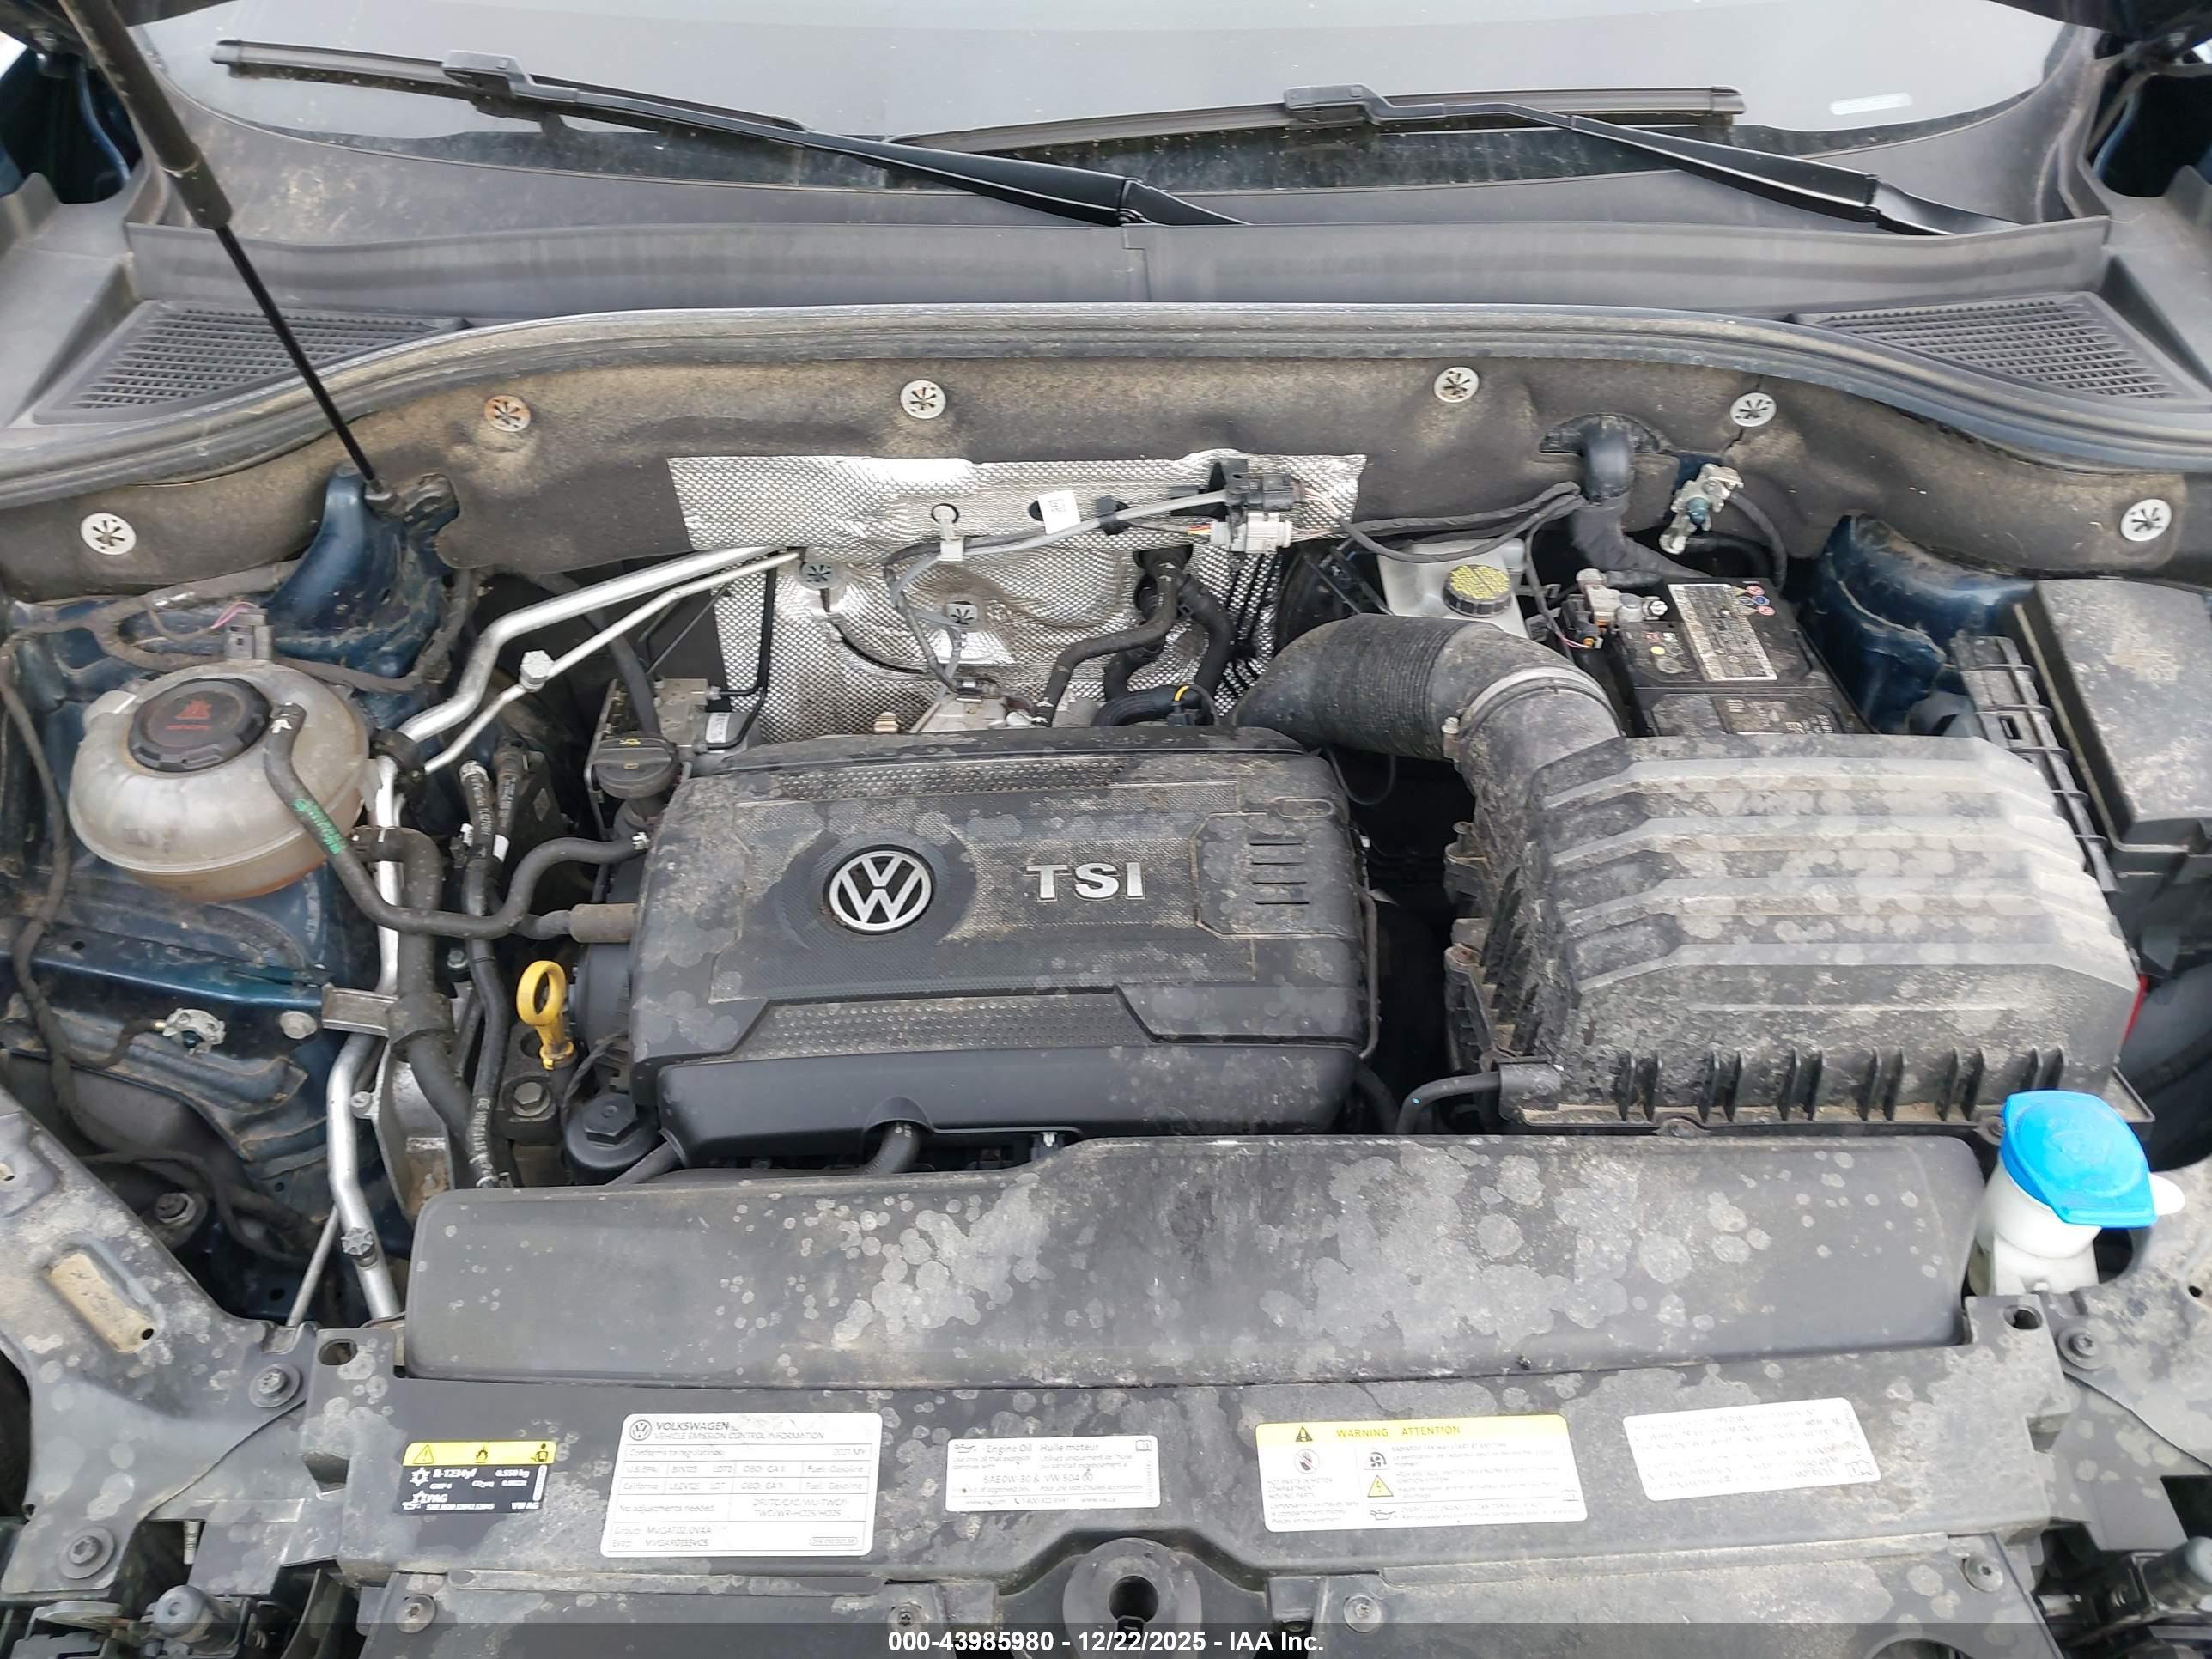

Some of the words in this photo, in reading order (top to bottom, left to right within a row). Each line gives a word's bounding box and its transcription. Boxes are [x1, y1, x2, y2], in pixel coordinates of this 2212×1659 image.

[1025, 861, 1145, 900] TSI
[829, 849, 933, 933] VW
[656, 1421, 730, 1431] VOLKSWAGEN
[1336, 1428, 1389, 1438] WARNING
[1401, 1425, 1462, 1437] ATTENTION
[987, 1444, 1018, 1455] Engine
[1018, 1443, 1032, 1452] Oil
